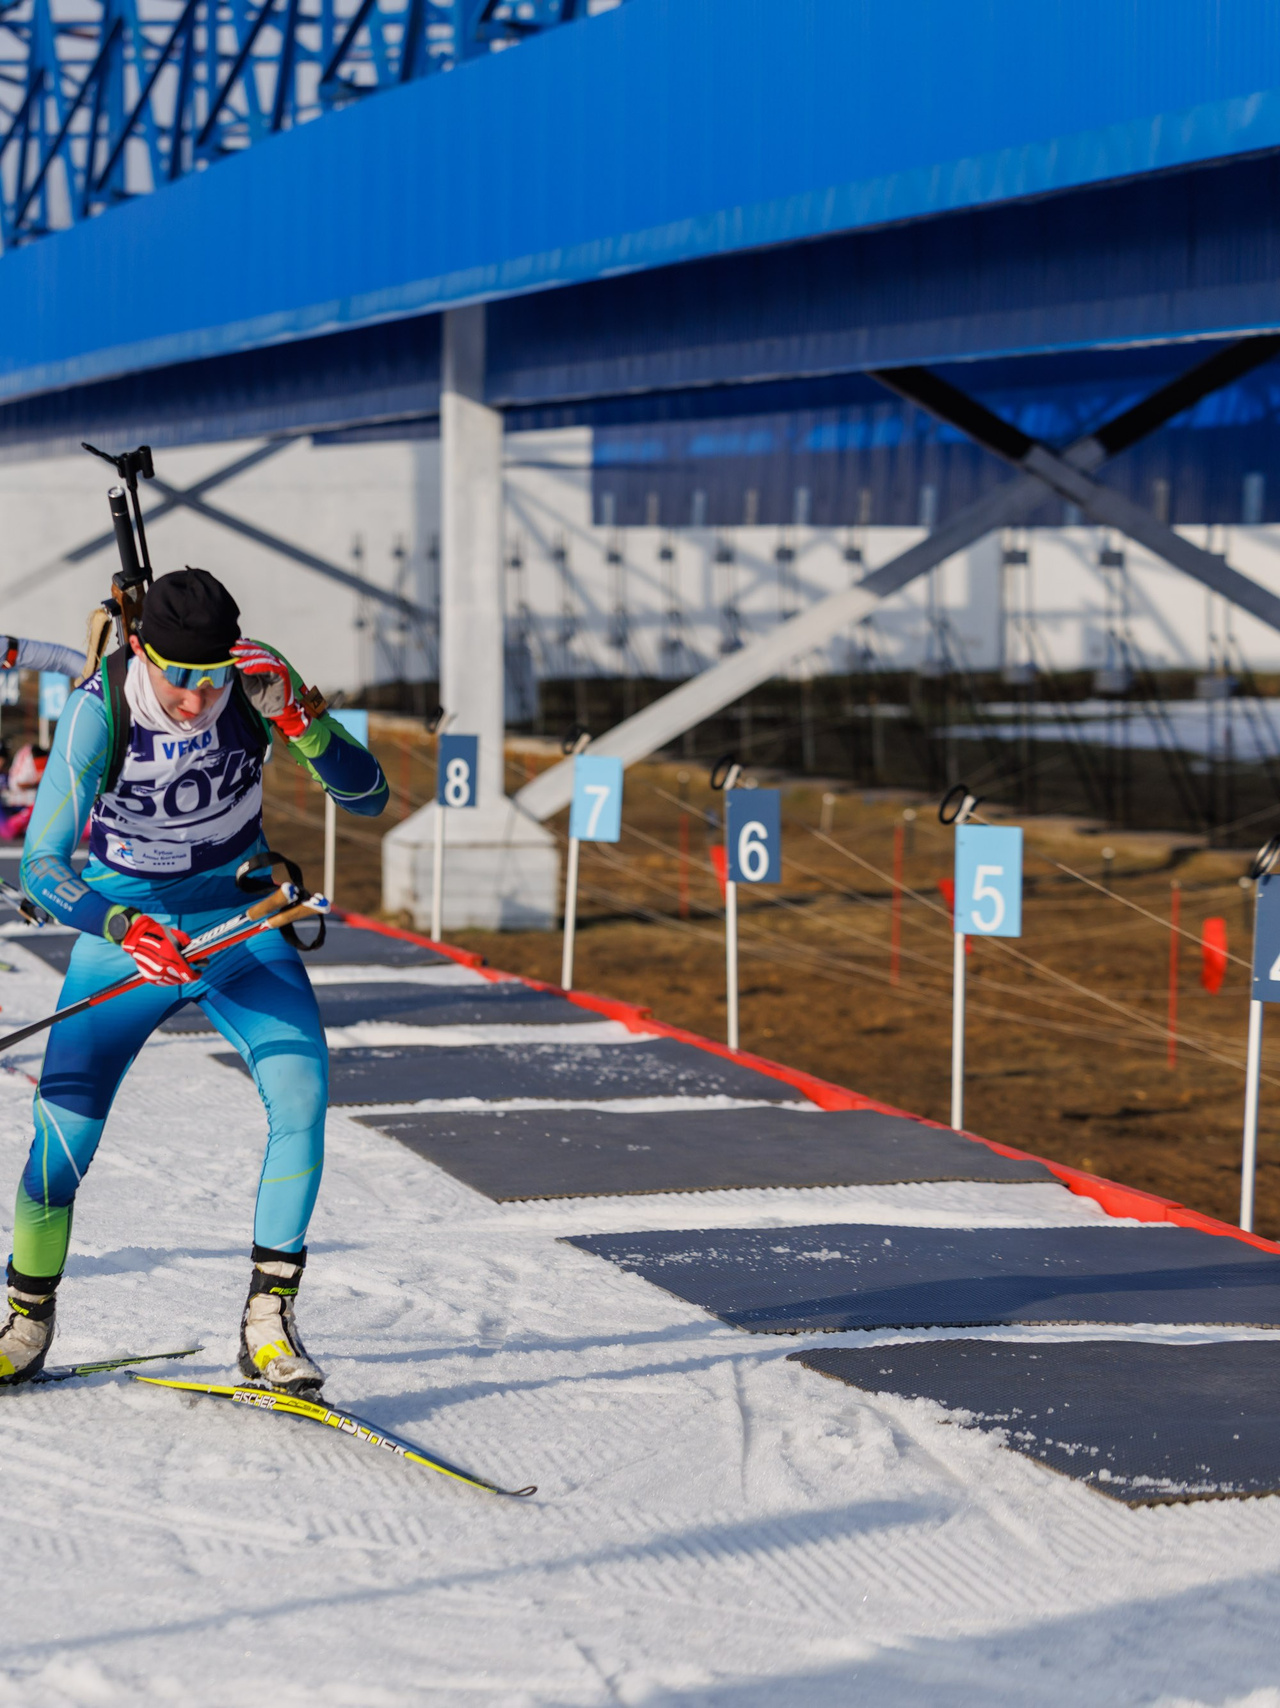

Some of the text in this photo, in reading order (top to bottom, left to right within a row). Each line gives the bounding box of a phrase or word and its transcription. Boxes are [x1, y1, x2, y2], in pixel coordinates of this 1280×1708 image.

[162, 730, 213, 760] VEKA
[114, 749, 258, 818] 504
[444, 758, 471, 808] 8
[584, 785, 610, 837] 7
[738, 820, 769, 882] 6
[41, 888, 74, 913] BIATHLON
[971, 864, 1005, 932] 5
[232, 1390, 277, 1410] FISCHER
